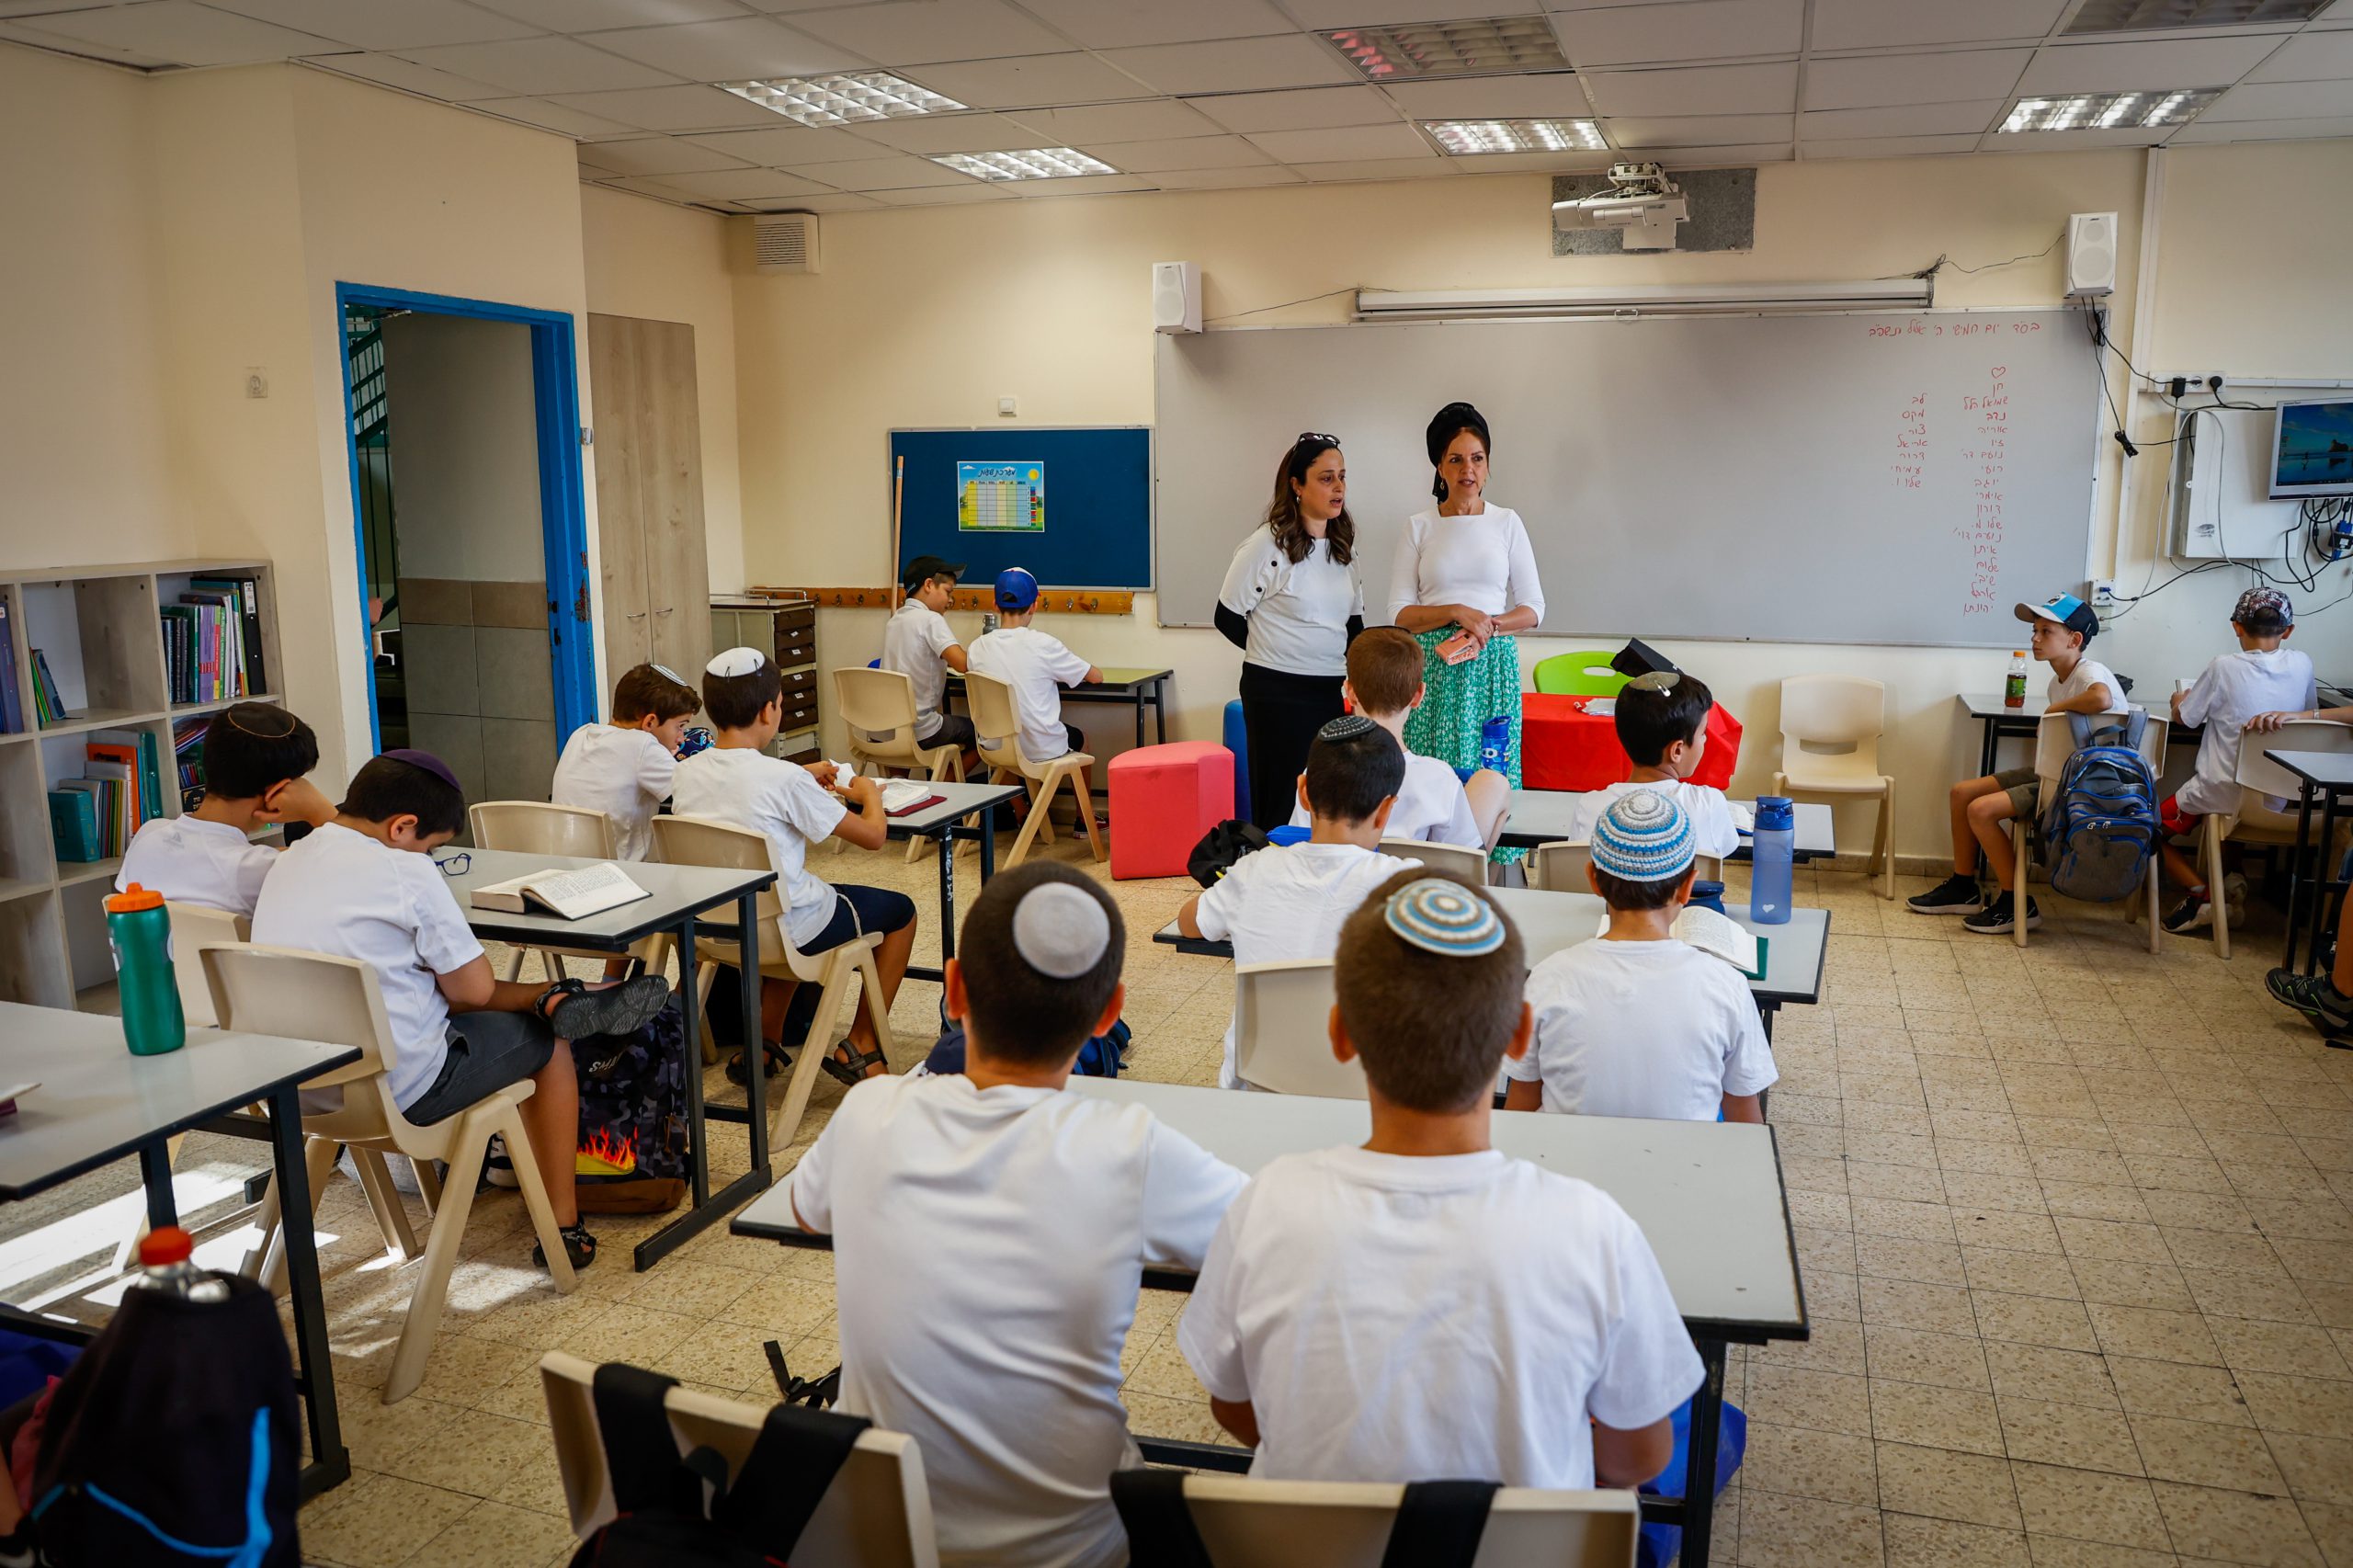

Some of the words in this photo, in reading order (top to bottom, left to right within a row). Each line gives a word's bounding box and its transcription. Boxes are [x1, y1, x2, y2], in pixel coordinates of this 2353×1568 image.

[1952, 323, 1979, 335] חמישי
[1985, 324, 2000, 334] יום
[1993, 382, 2004, 398] חן
[1912, 392, 1928, 404] לב
[1983, 395, 2008, 408] שמואל
[1902, 408, 1925, 422] מקס
[1986, 412, 2006, 421] נדב
[1908, 424, 1927, 435] צור
[1899, 451, 1925, 460] דרור
[1981, 450, 2003, 460] נועם
[1981, 464, 2004, 474] רועי
[1977, 504, 2001, 517] דורון
[1973, 544, 1997, 557] איתן
[1976, 557, 2000, 573] שלום
[1963, 603, 1994, 617] יהונתן
